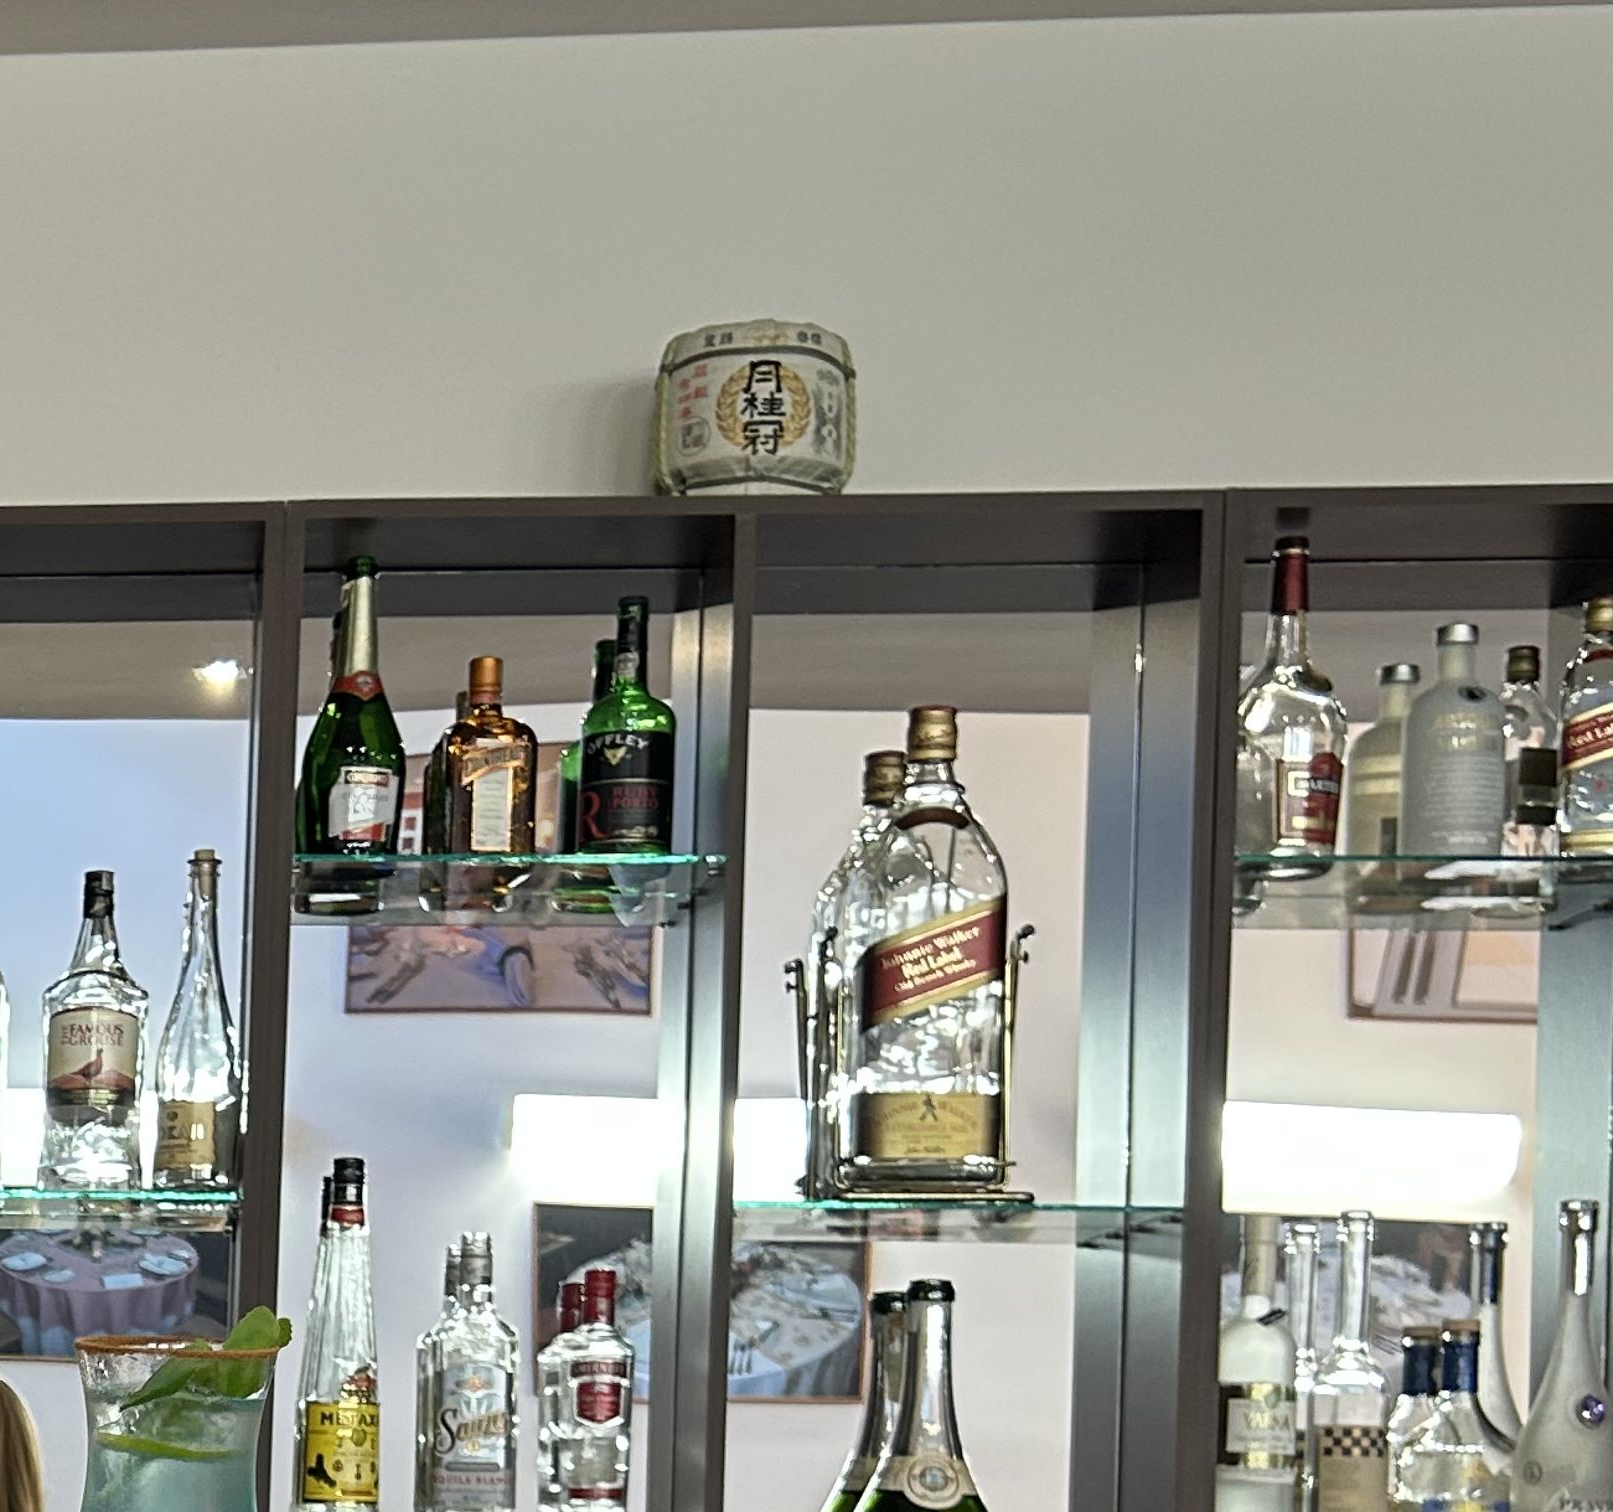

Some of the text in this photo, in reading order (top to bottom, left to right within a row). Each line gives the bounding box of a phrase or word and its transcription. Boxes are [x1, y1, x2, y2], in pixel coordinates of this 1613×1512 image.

[741, 360, 785, 455] 月桂冠
[587, 734, 649, 755] OFFLEY
[933, 926, 979, 950] Walker
[69, 1024, 124, 1035] FAMOUS
